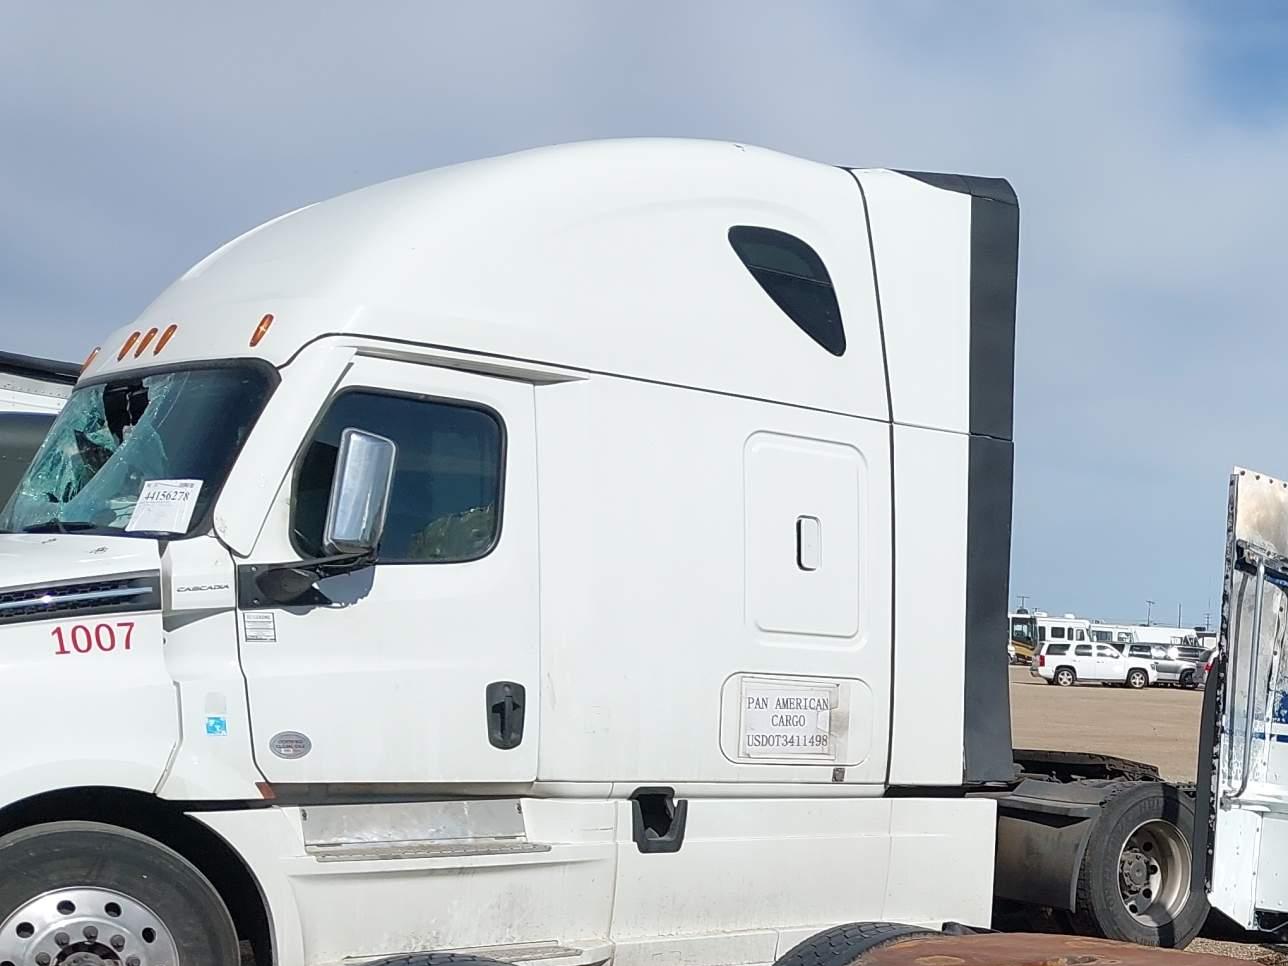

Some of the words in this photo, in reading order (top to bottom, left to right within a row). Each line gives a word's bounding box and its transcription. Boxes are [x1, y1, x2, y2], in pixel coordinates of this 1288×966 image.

[144, 490, 190, 502] 44156278
[177, 584, 230, 592] CASCADIA
[51, 622, 135, 655] 1007
[746, 696, 769, 710] PAN
[775, 696, 829, 711] AMERICAN
[770, 714, 806, 727] CARGO
[746, 734, 828, 747] USDOT3411498
